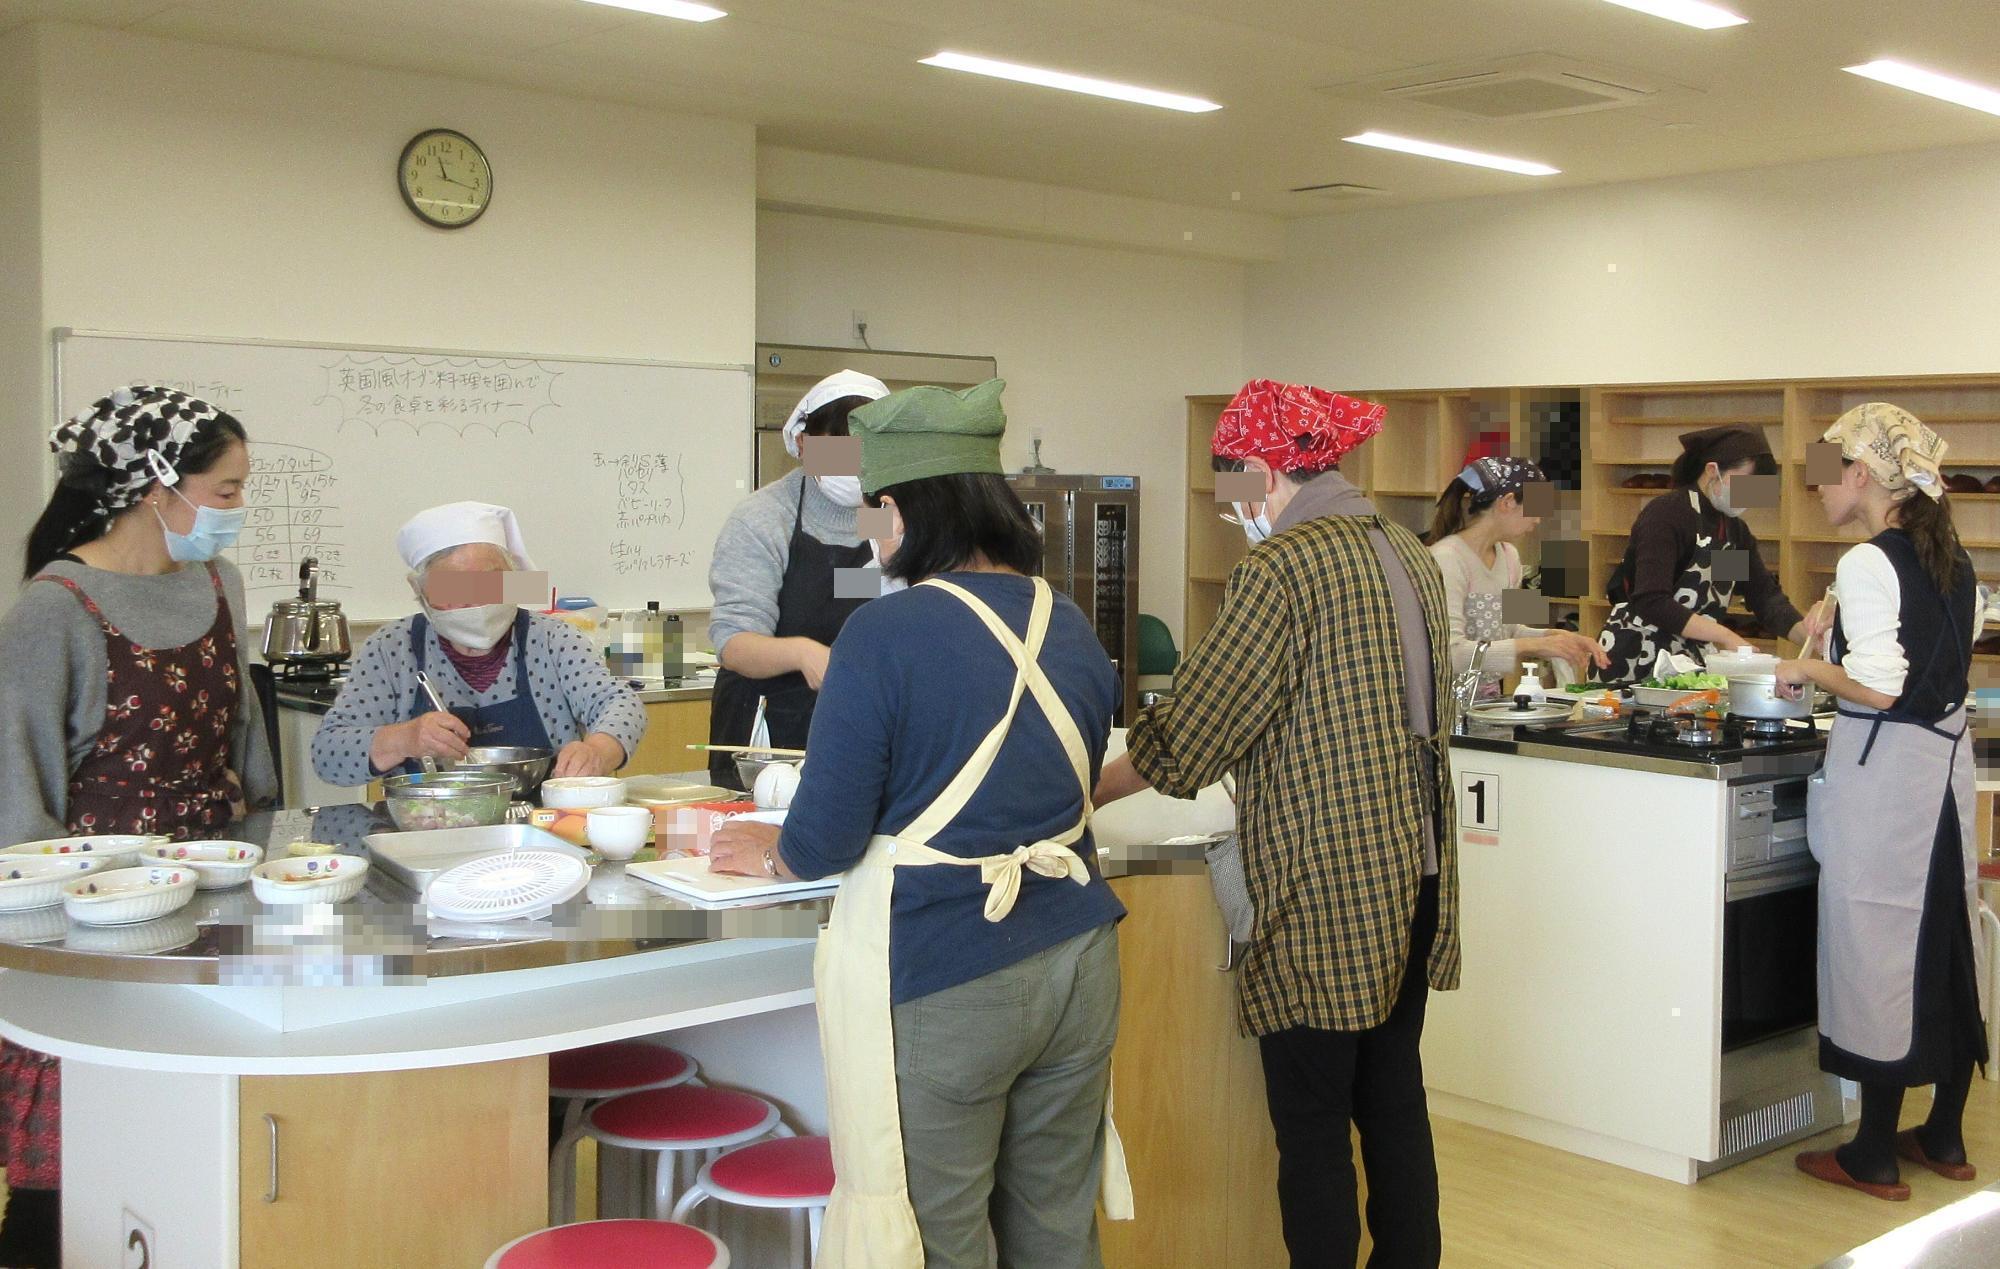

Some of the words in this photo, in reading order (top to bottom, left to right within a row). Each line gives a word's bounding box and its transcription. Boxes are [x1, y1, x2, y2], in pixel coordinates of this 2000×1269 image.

[427, 145, 437, 156] 11
[440, 141, 452, 153] 12
[416, 155, 427, 166] 10
[469, 162, 478, 172] 2
[411, 169, 418, 179] 9
[474, 178, 480, 188] 3
[416, 186, 423, 197] 8
[442, 205, 449, 216] 6
[251, 489, 275, 504] 75
[300, 489, 321, 504] 95
[243, 507, 274, 525] 150
[255, 527, 276, 542] 56
[303, 527, 321, 542] 69
[1468, 780, 1485, 824] 1
